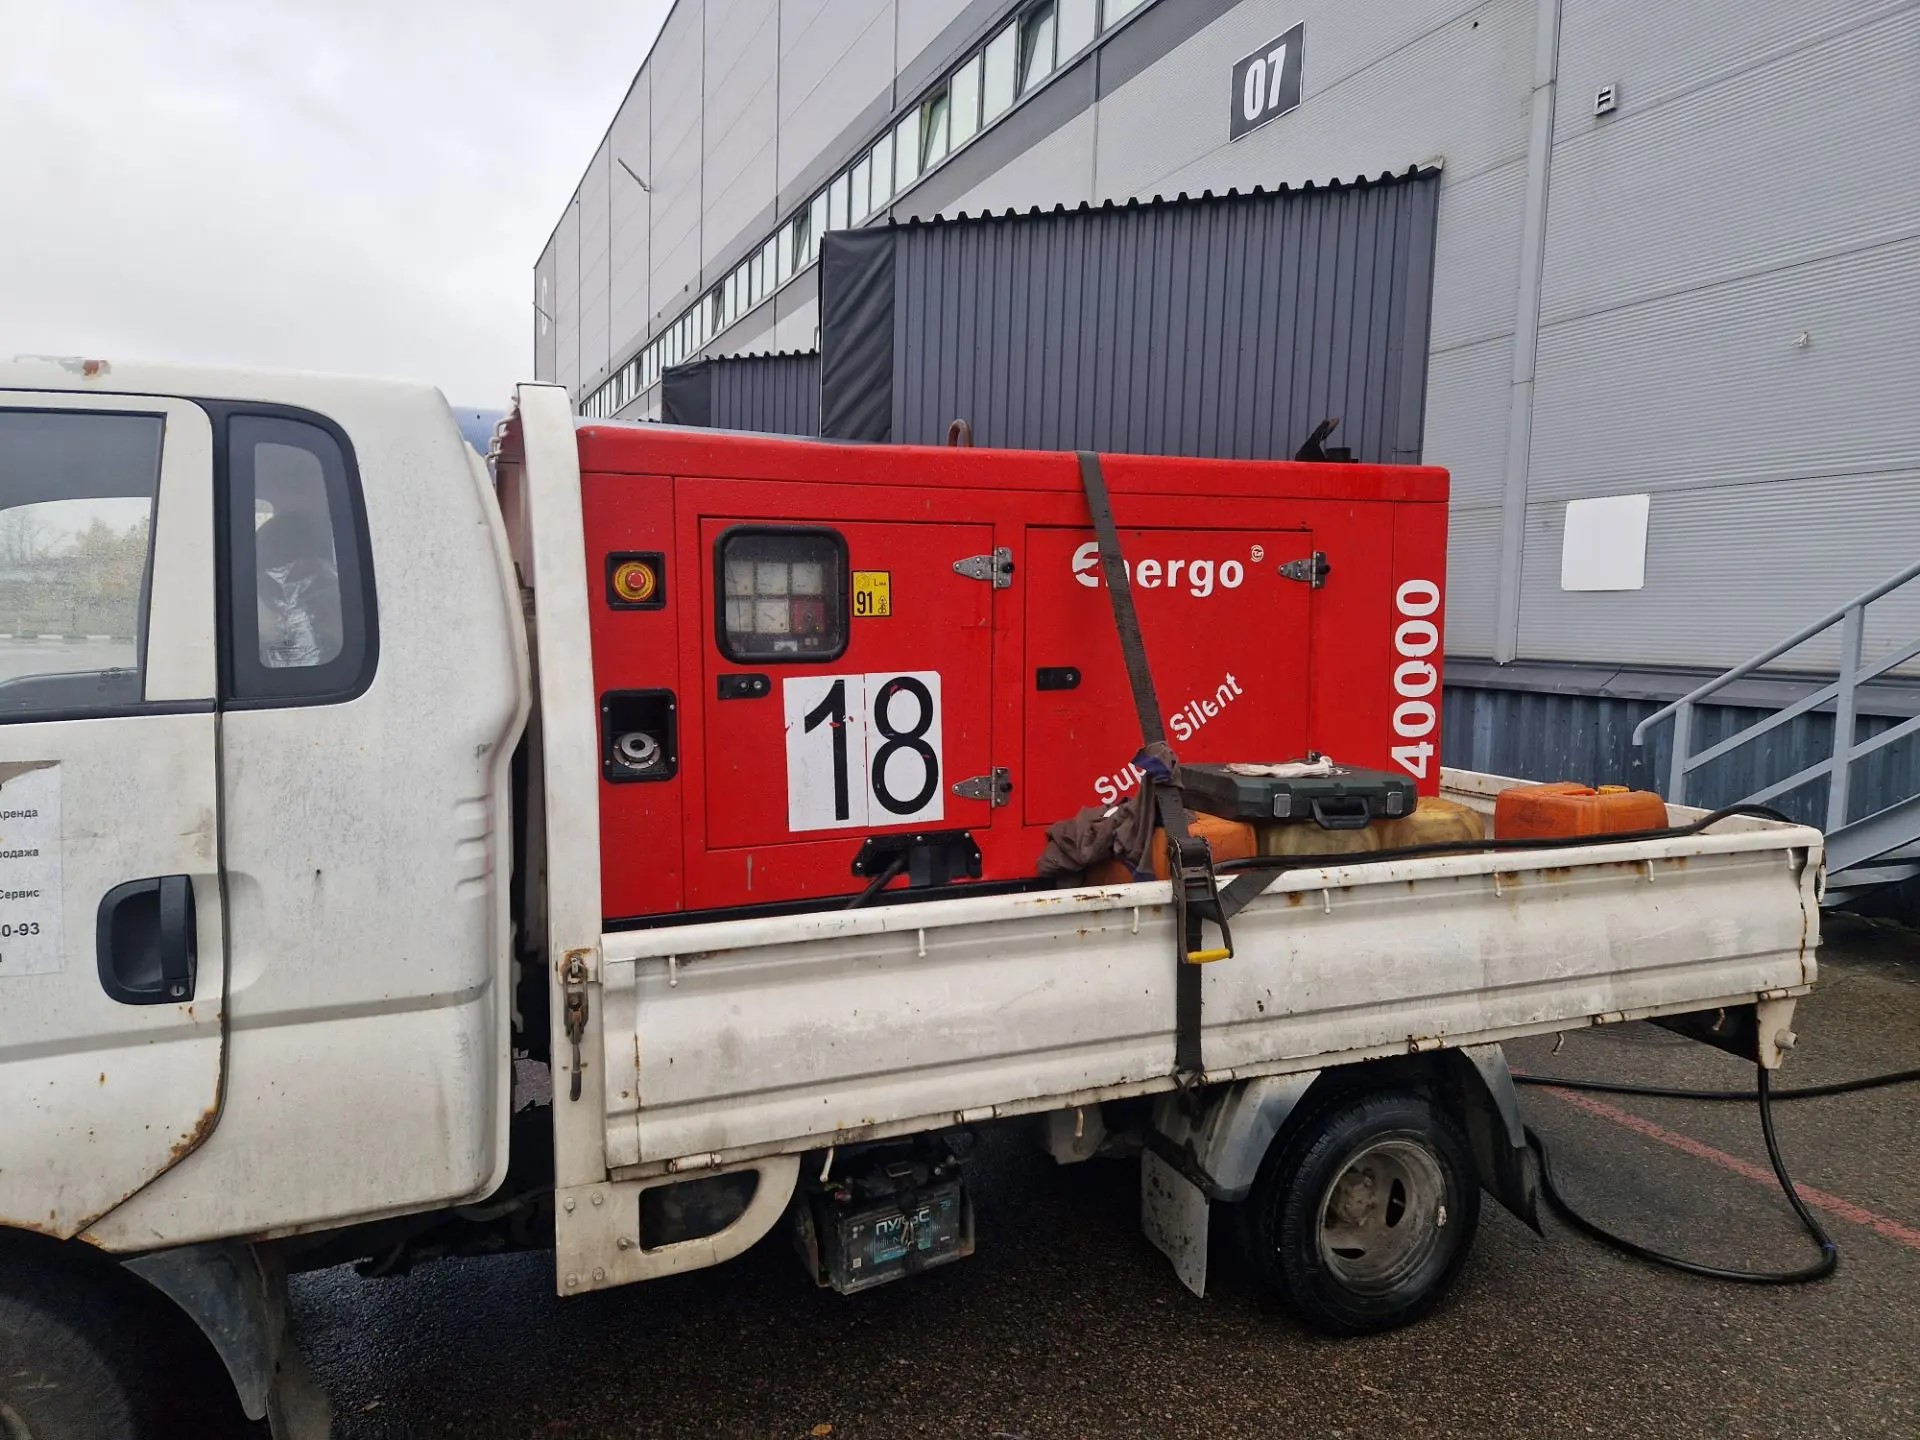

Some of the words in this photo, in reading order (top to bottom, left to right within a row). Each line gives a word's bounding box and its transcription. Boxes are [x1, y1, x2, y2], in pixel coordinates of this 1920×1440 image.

[1243, 43, 1287, 121] 07
[856, 590, 873, 614] 91
[1169, 671, 1244, 742] Silent
[1391, 579, 1440, 779] 40000
[804, 676, 939, 821] 18
[0, 922, 40, 938] 0-93
